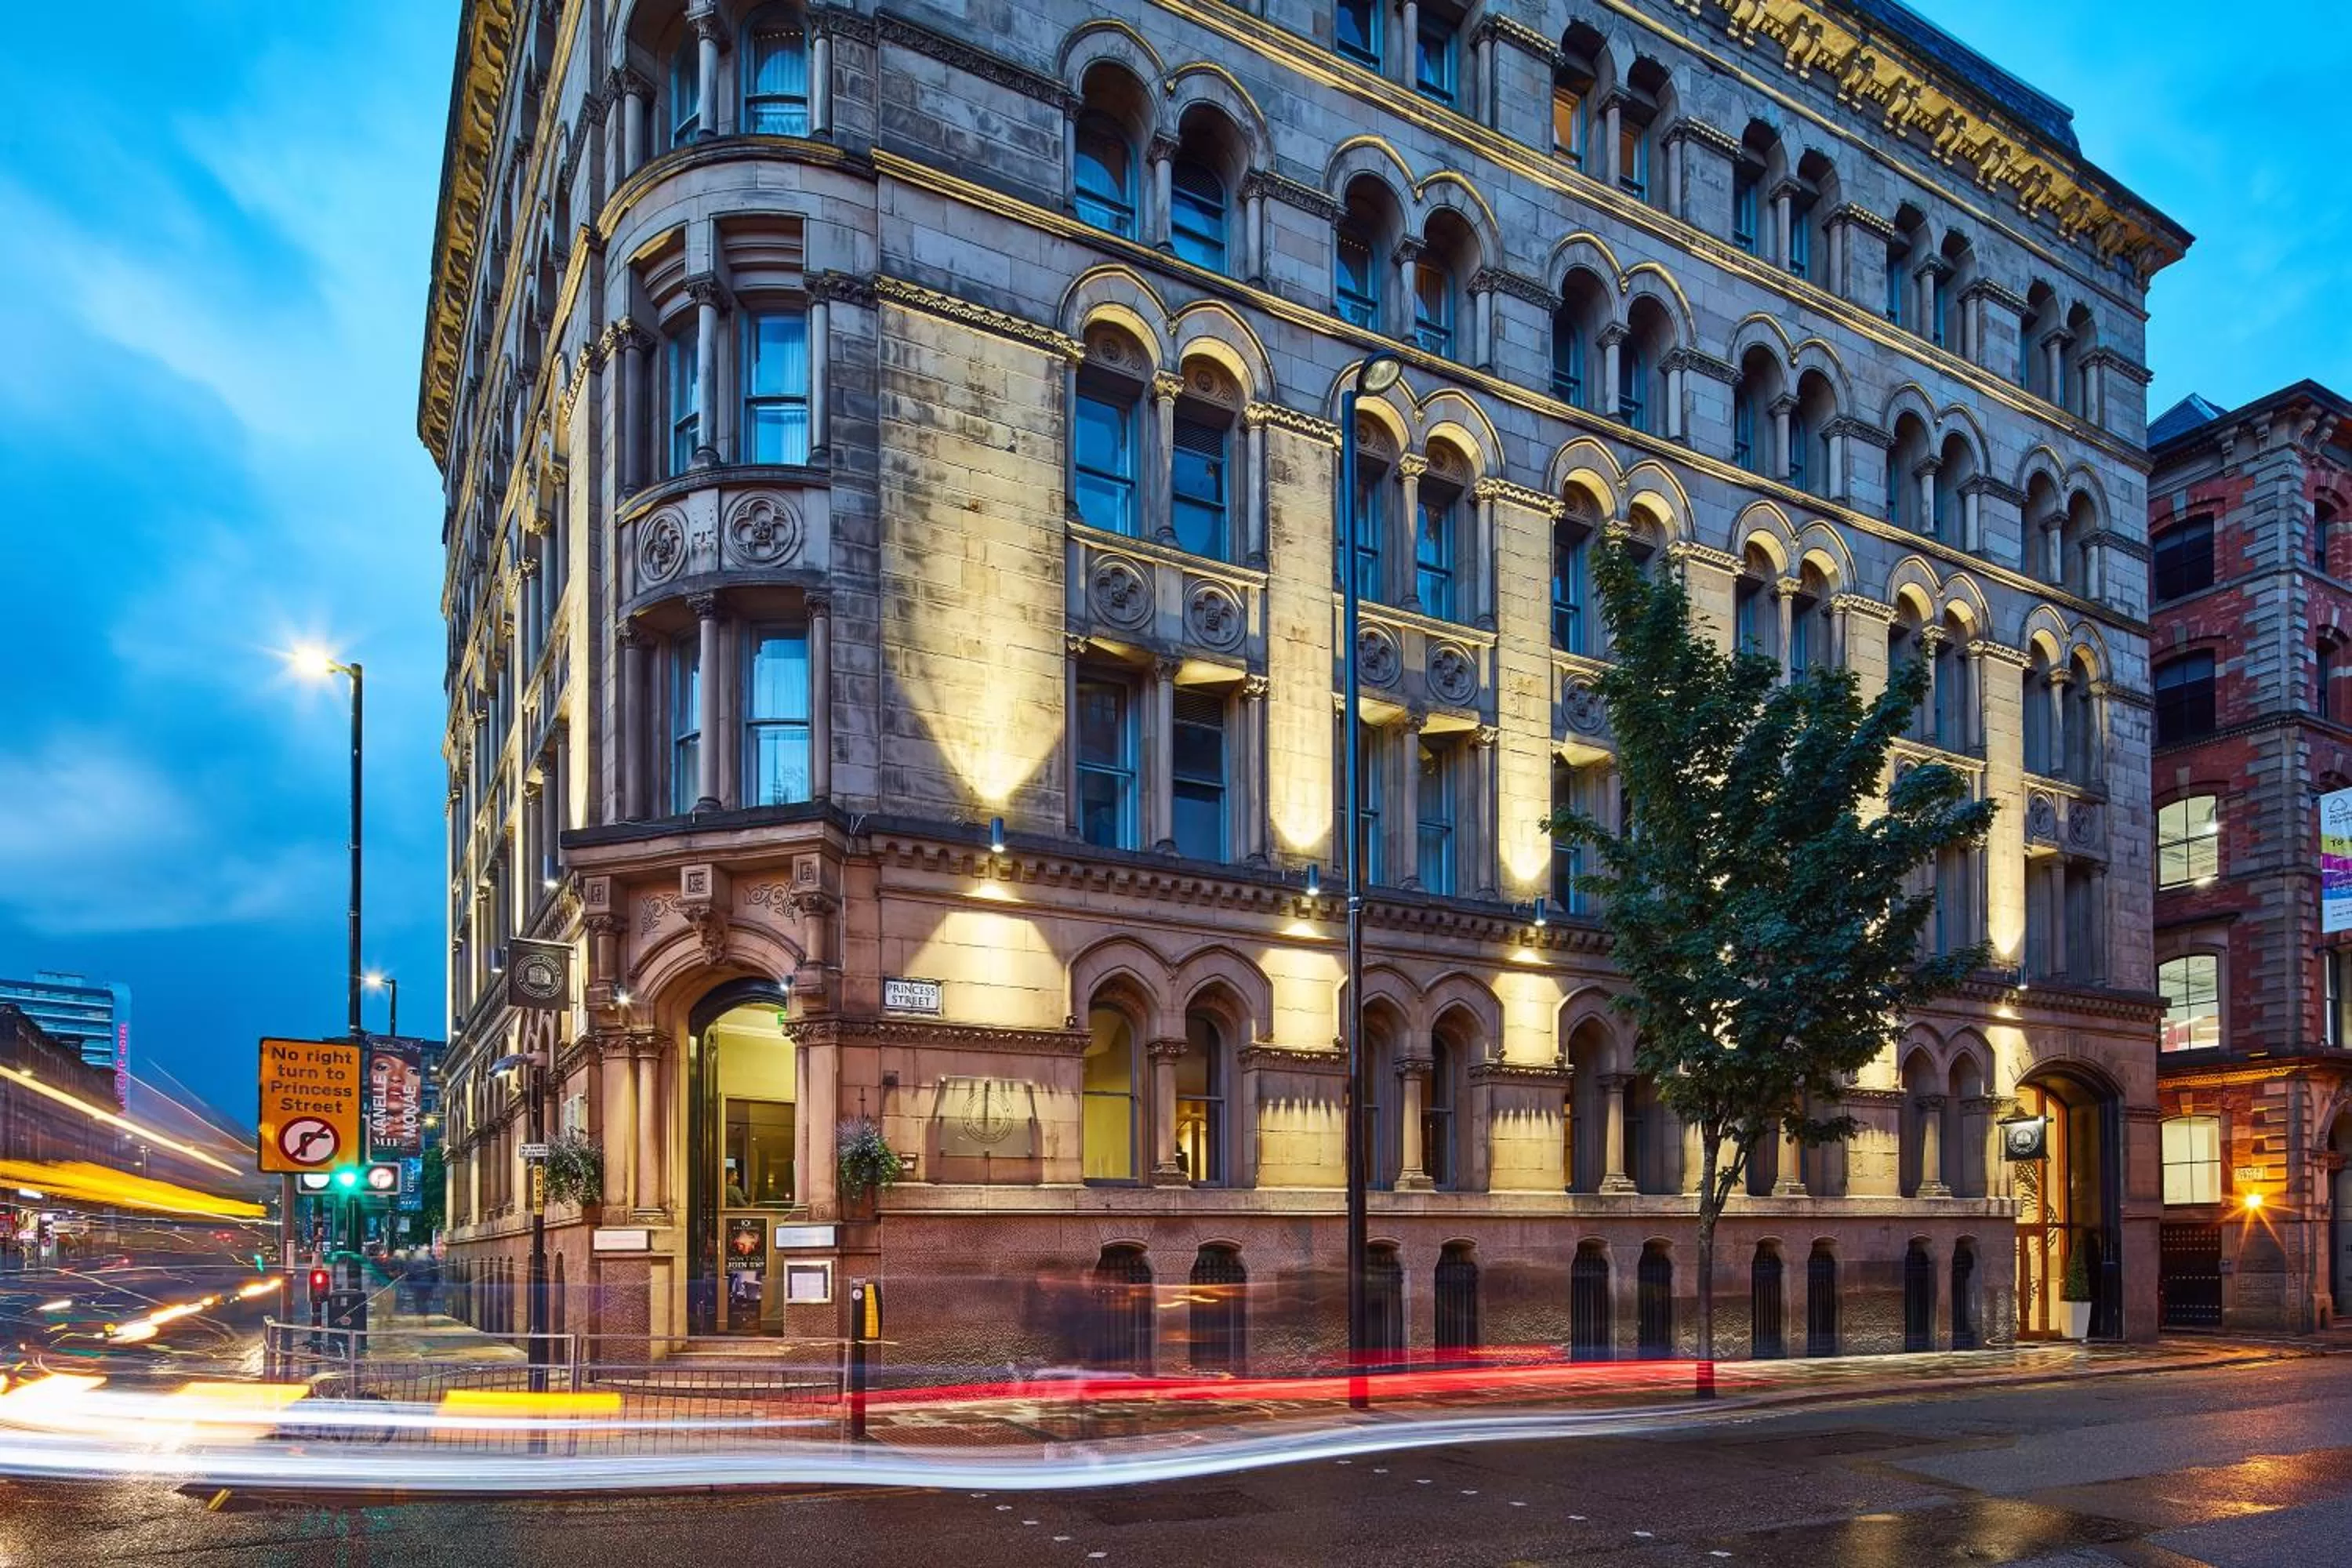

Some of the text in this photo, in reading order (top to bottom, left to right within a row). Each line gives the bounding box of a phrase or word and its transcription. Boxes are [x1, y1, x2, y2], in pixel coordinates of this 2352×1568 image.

[887, 983, 935, 996] PRINCESS
[891, 995, 931, 1006] STREET
[271, 1047, 352, 1065] No right
[278, 1064, 345, 1080] turn to
[270, 1080, 352, 1098] Princess
[280, 1098, 343, 1113] Street
[372, 1075, 387, 1136] JANELLE
